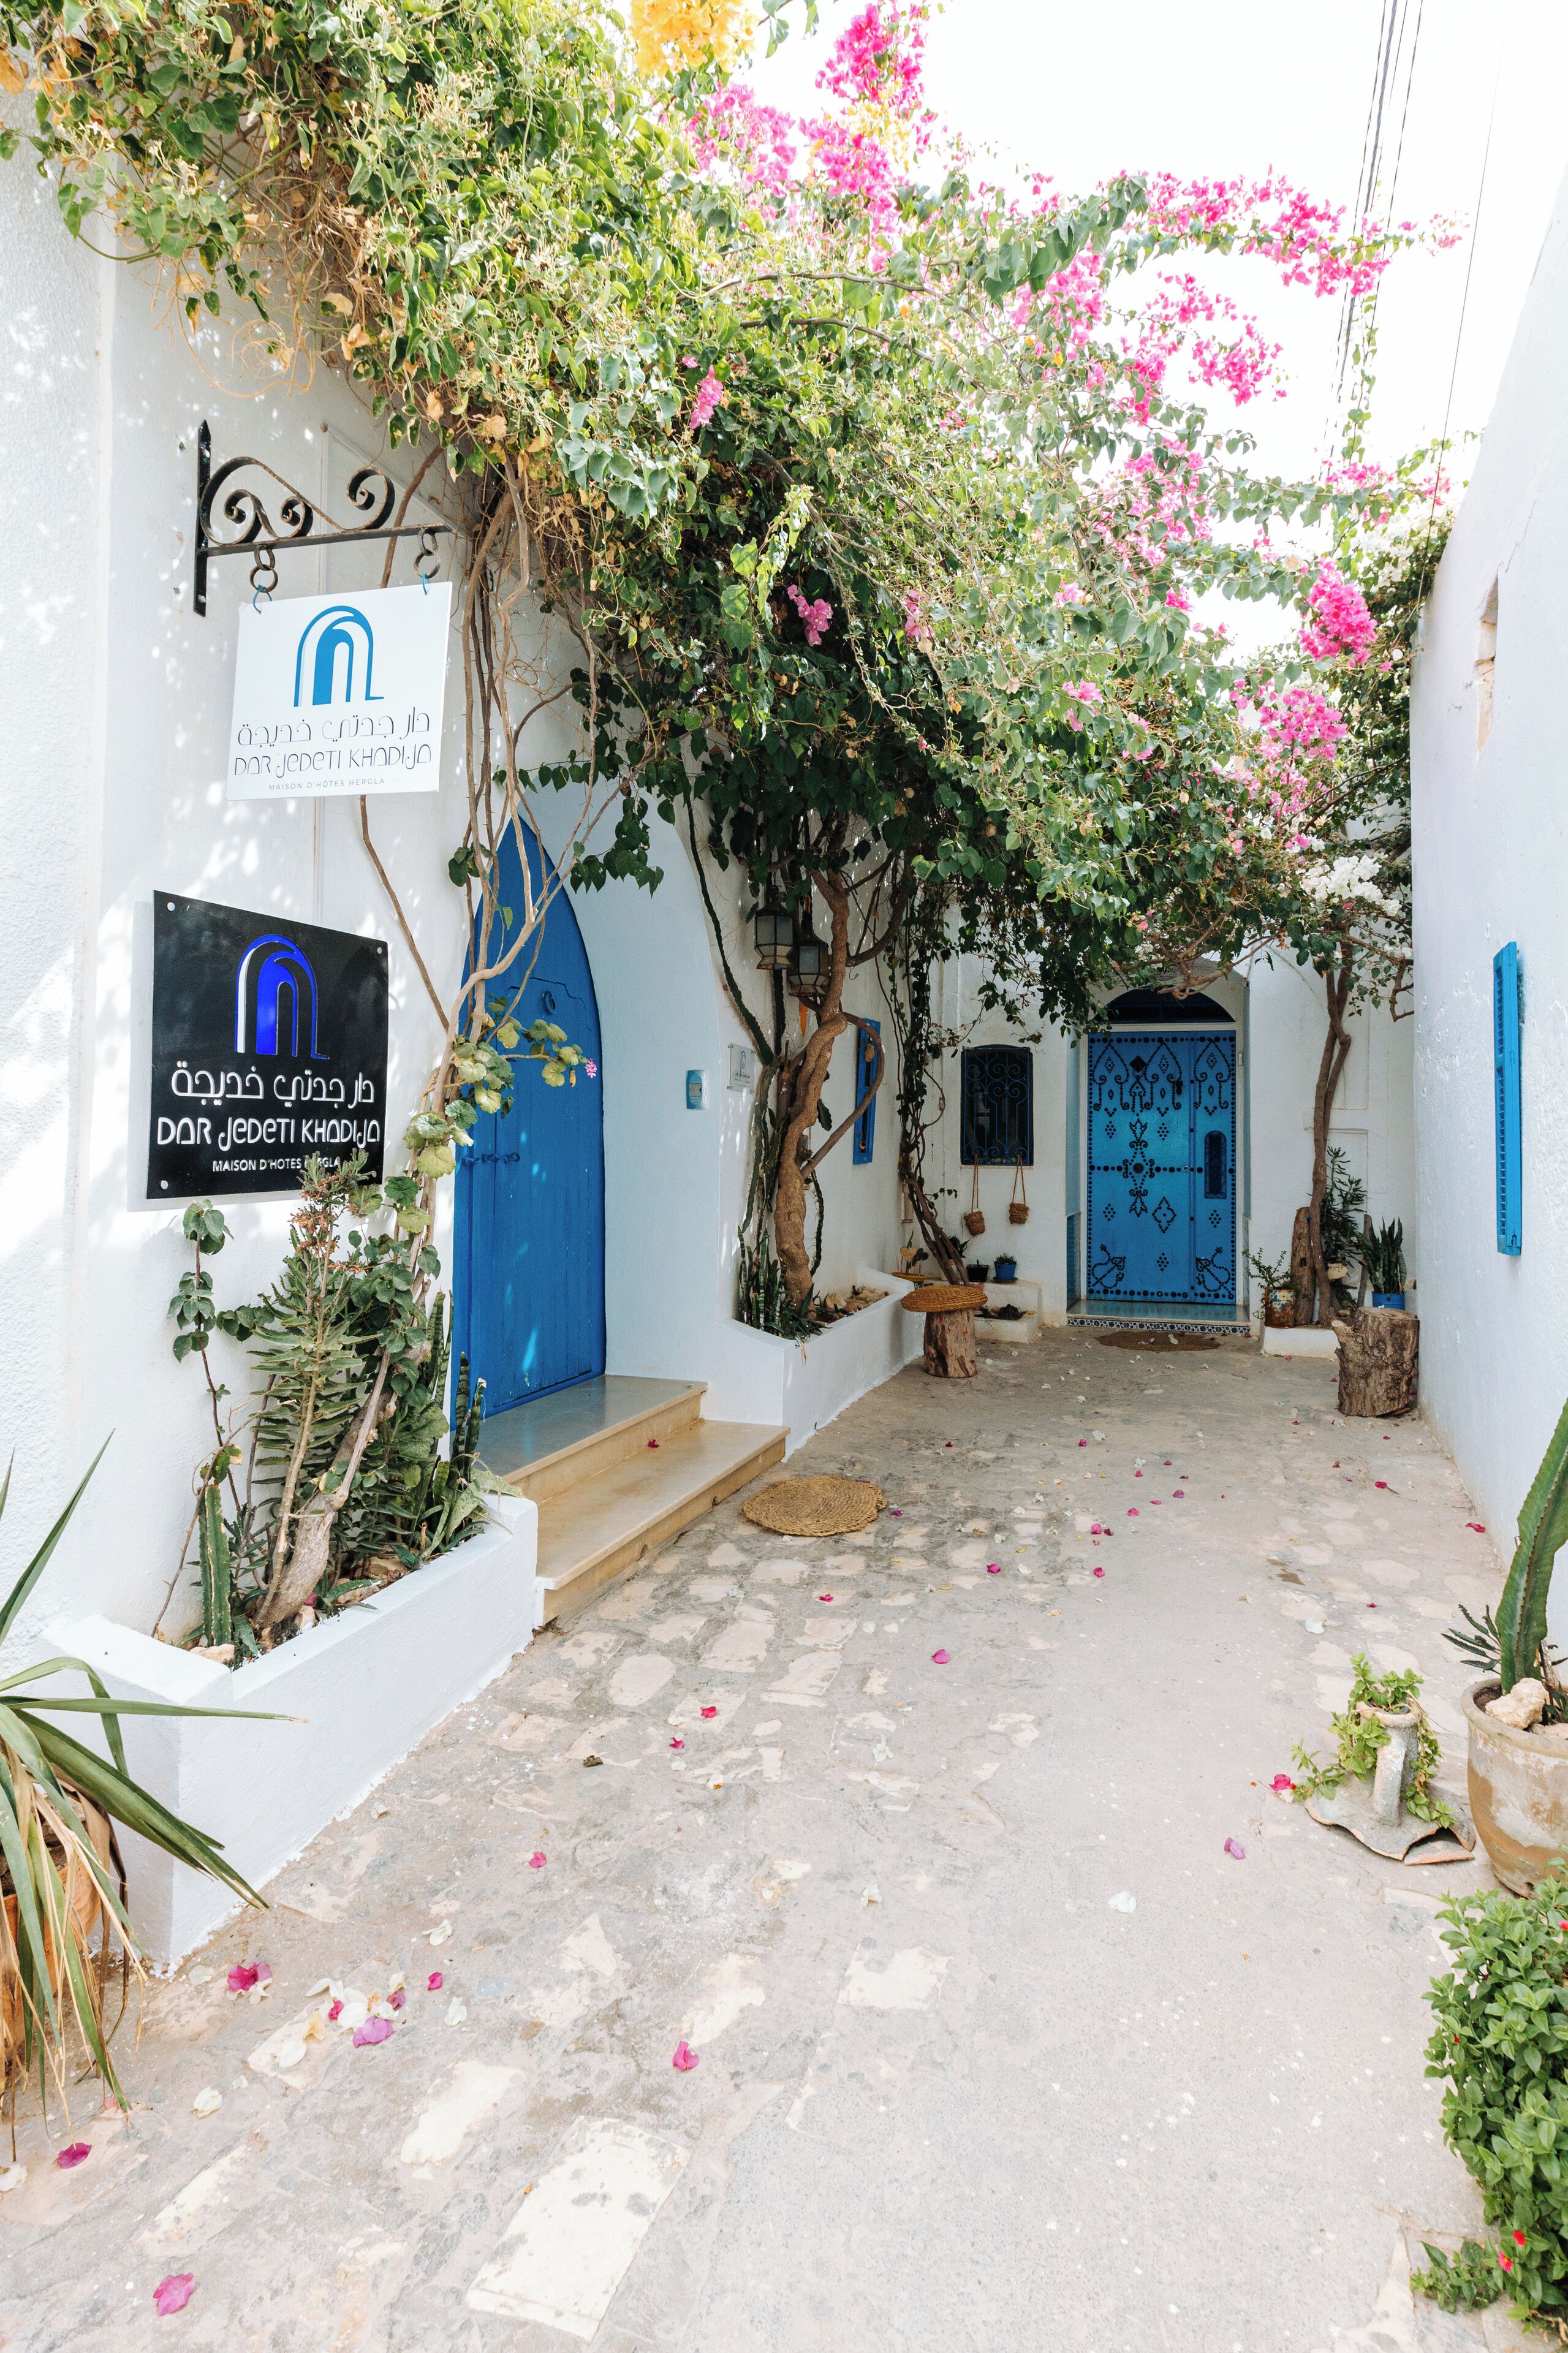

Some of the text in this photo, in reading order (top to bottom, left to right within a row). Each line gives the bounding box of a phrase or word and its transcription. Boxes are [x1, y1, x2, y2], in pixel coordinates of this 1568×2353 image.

[238, 707, 430, 748] دار جدتي خديجة
[234, 756, 271, 776] DAR
[349, 743, 431, 770] KHADIJA
[306, 779, 344, 789] D'HÔTES
[349, 778, 385, 786] HERGLA
[171, 1060, 375, 1109] دار جدتي خديجة
[157, 1116, 212, 1145] DAR
[301, 1118, 381, 1149] KHADIJA
[212, 1159, 257, 1172] MAISON
[259, 1158, 302, 1171] D'HOTES
